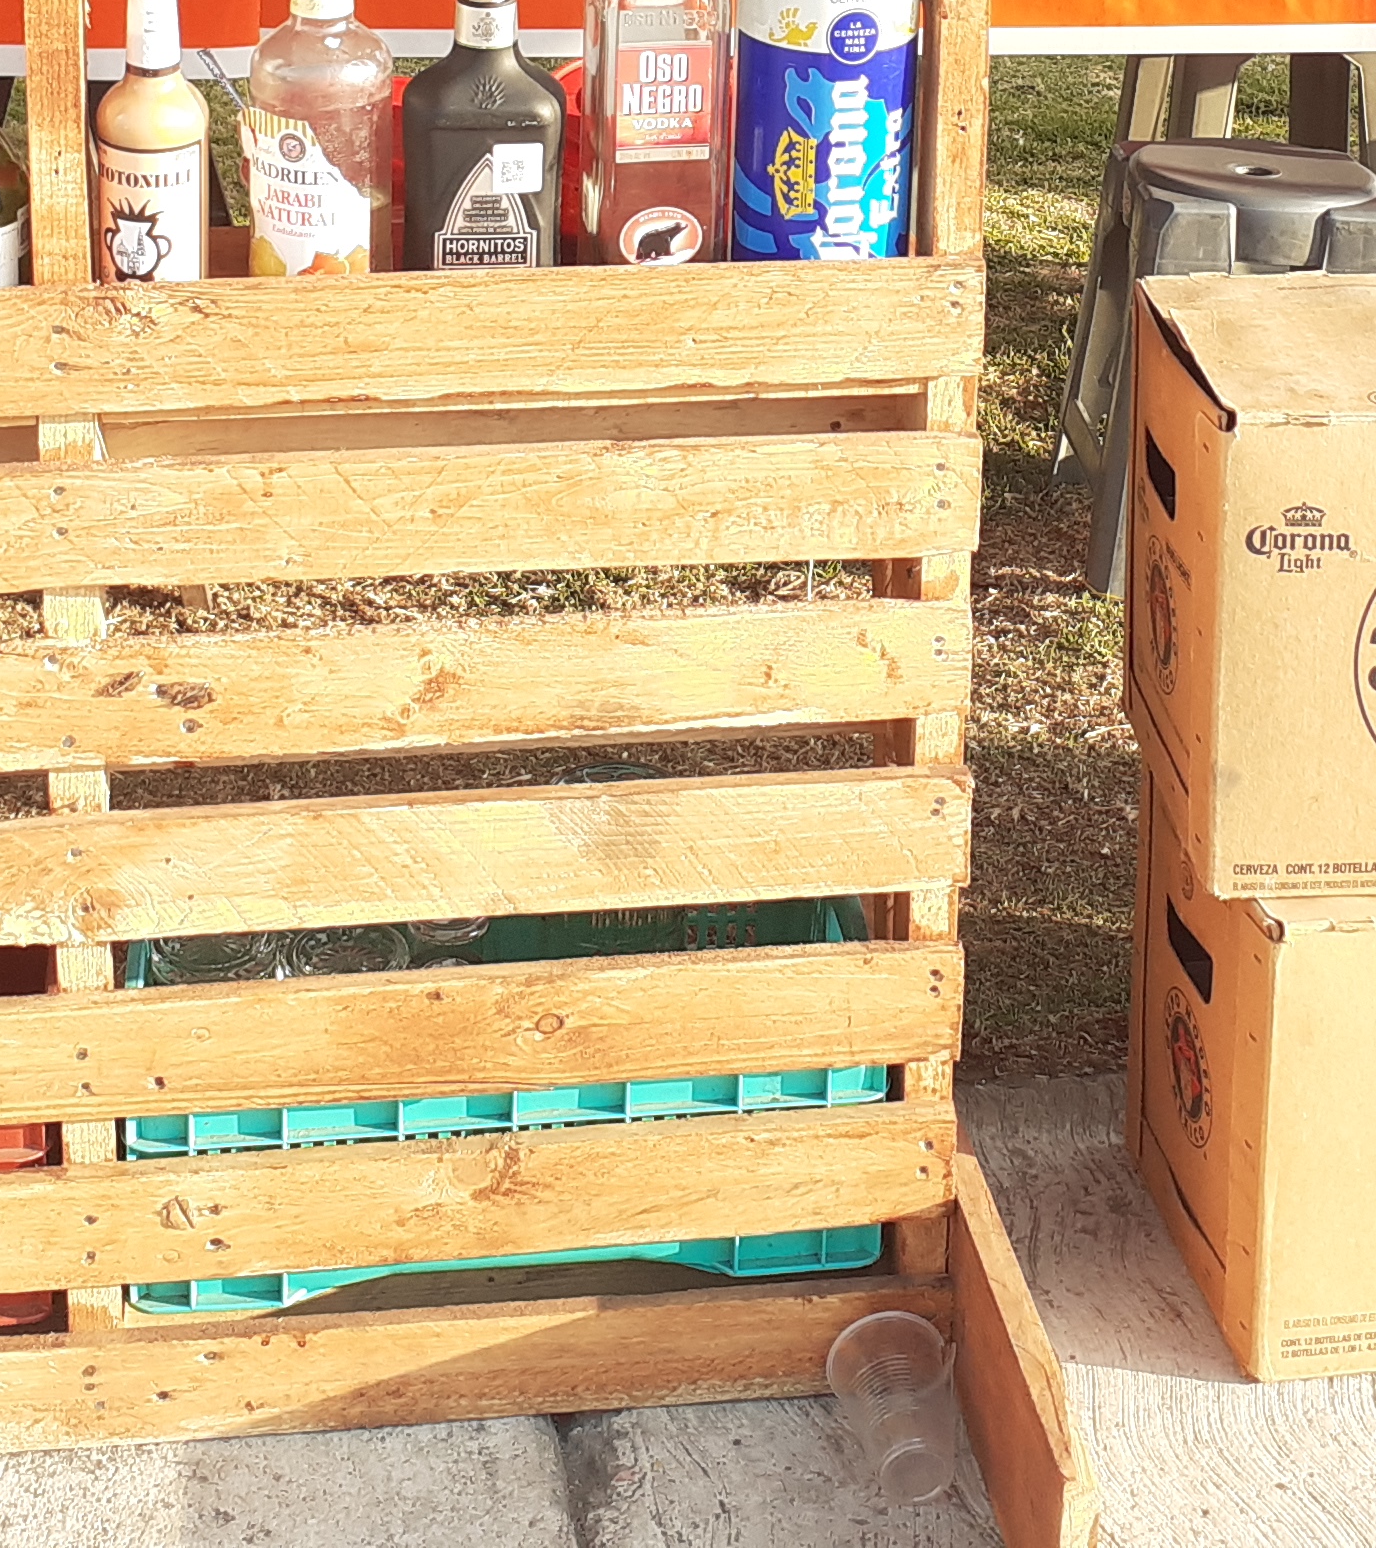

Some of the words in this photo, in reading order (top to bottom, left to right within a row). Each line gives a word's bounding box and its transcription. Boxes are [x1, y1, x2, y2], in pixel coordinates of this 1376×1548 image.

[638, 50, 689, 84] OSO
[622, 83, 703, 116] NEGRO
[632, 117, 694, 130] VODKA
[445, 238, 525, 253] HORNITOS
[445, 254, 480, 264] BLACK
[483, 253, 525, 263] BARREL
[1245, 525, 1352, 560] Corona
[1276, 552, 1323, 573] Light
[1233, 864, 1279, 875] CERVEZA
[1285, 863, 1315, 875] CONT.
[1318, 863, 1330, 874] 12
